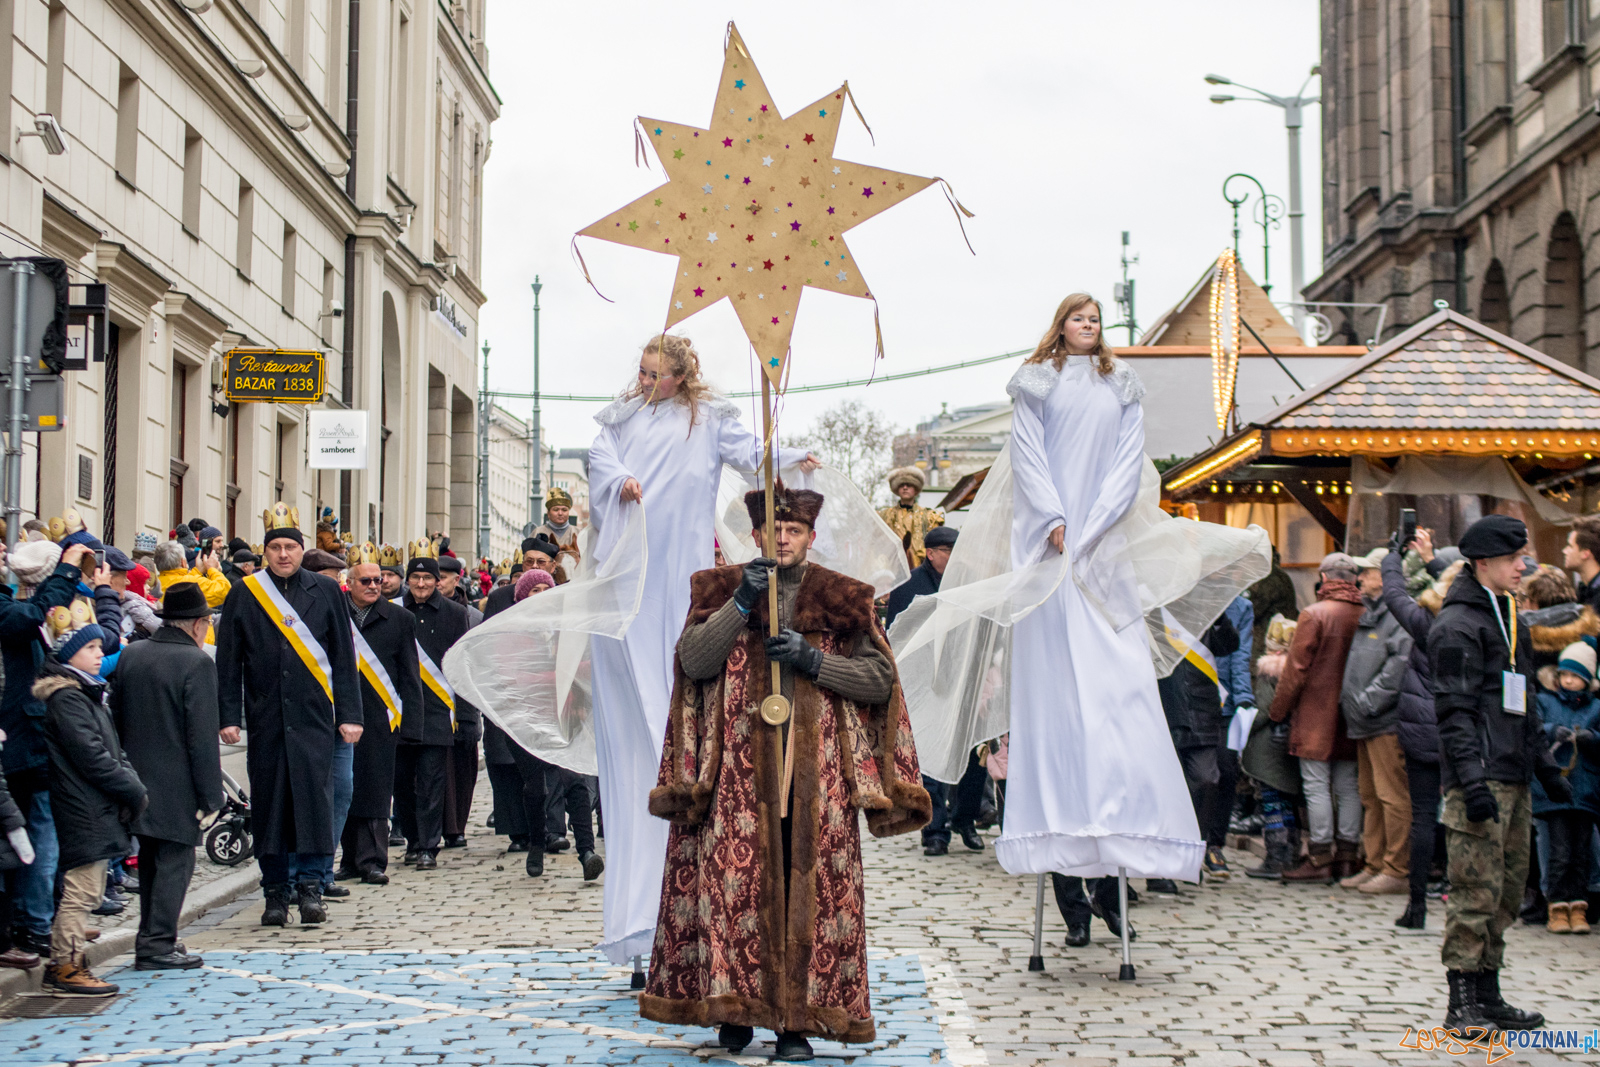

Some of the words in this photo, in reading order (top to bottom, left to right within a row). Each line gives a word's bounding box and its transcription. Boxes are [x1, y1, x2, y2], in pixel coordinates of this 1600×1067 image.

[235, 355, 313, 373] Restaurant
[234, 376, 276, 391] BAZAR
[283, 377, 314, 391] 1838
[320, 446, 355, 454] sambonet
